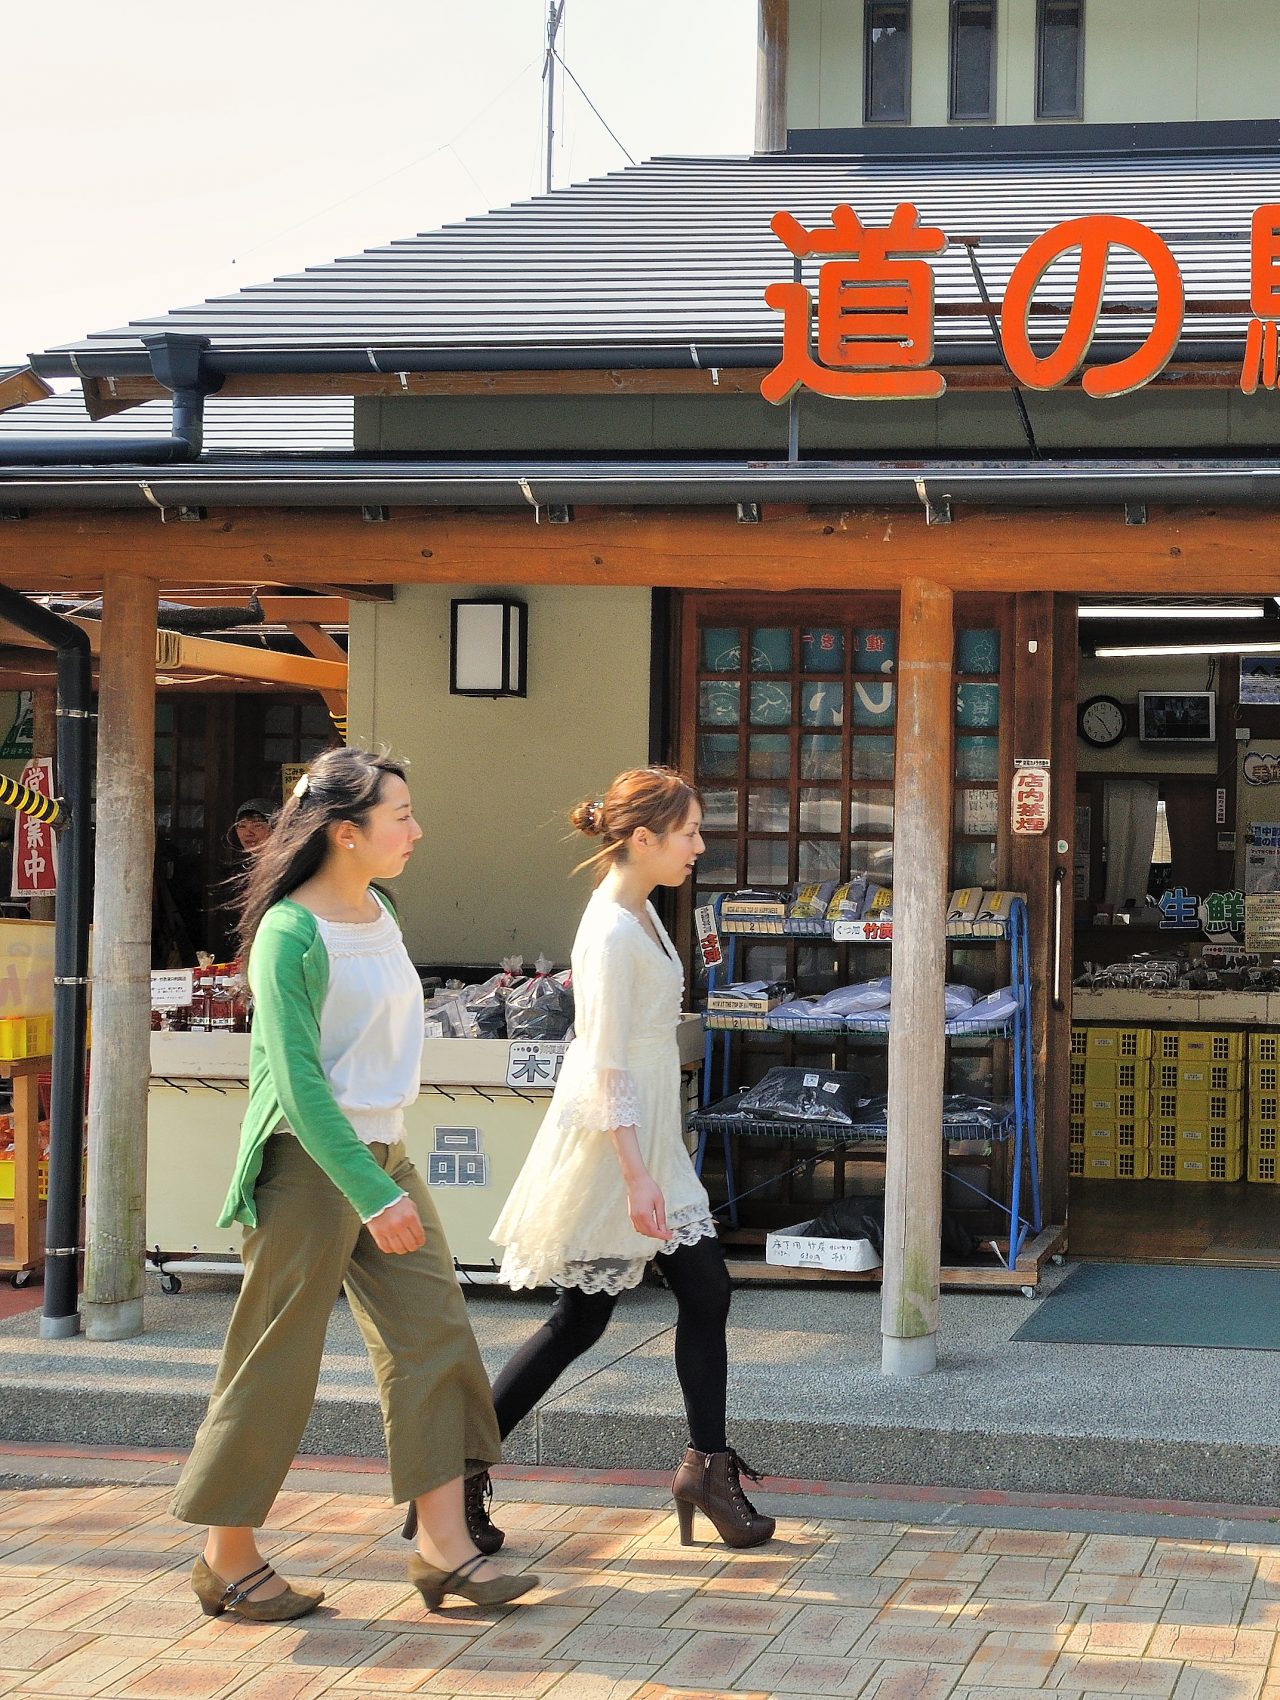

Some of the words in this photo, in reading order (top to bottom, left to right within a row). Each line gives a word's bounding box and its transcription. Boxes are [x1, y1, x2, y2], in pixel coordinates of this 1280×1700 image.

[1016, 773, 1045, 832] 店内禁煙
[749, 922, 755, 931] 2
[734, 1020, 739, 1028] 2
